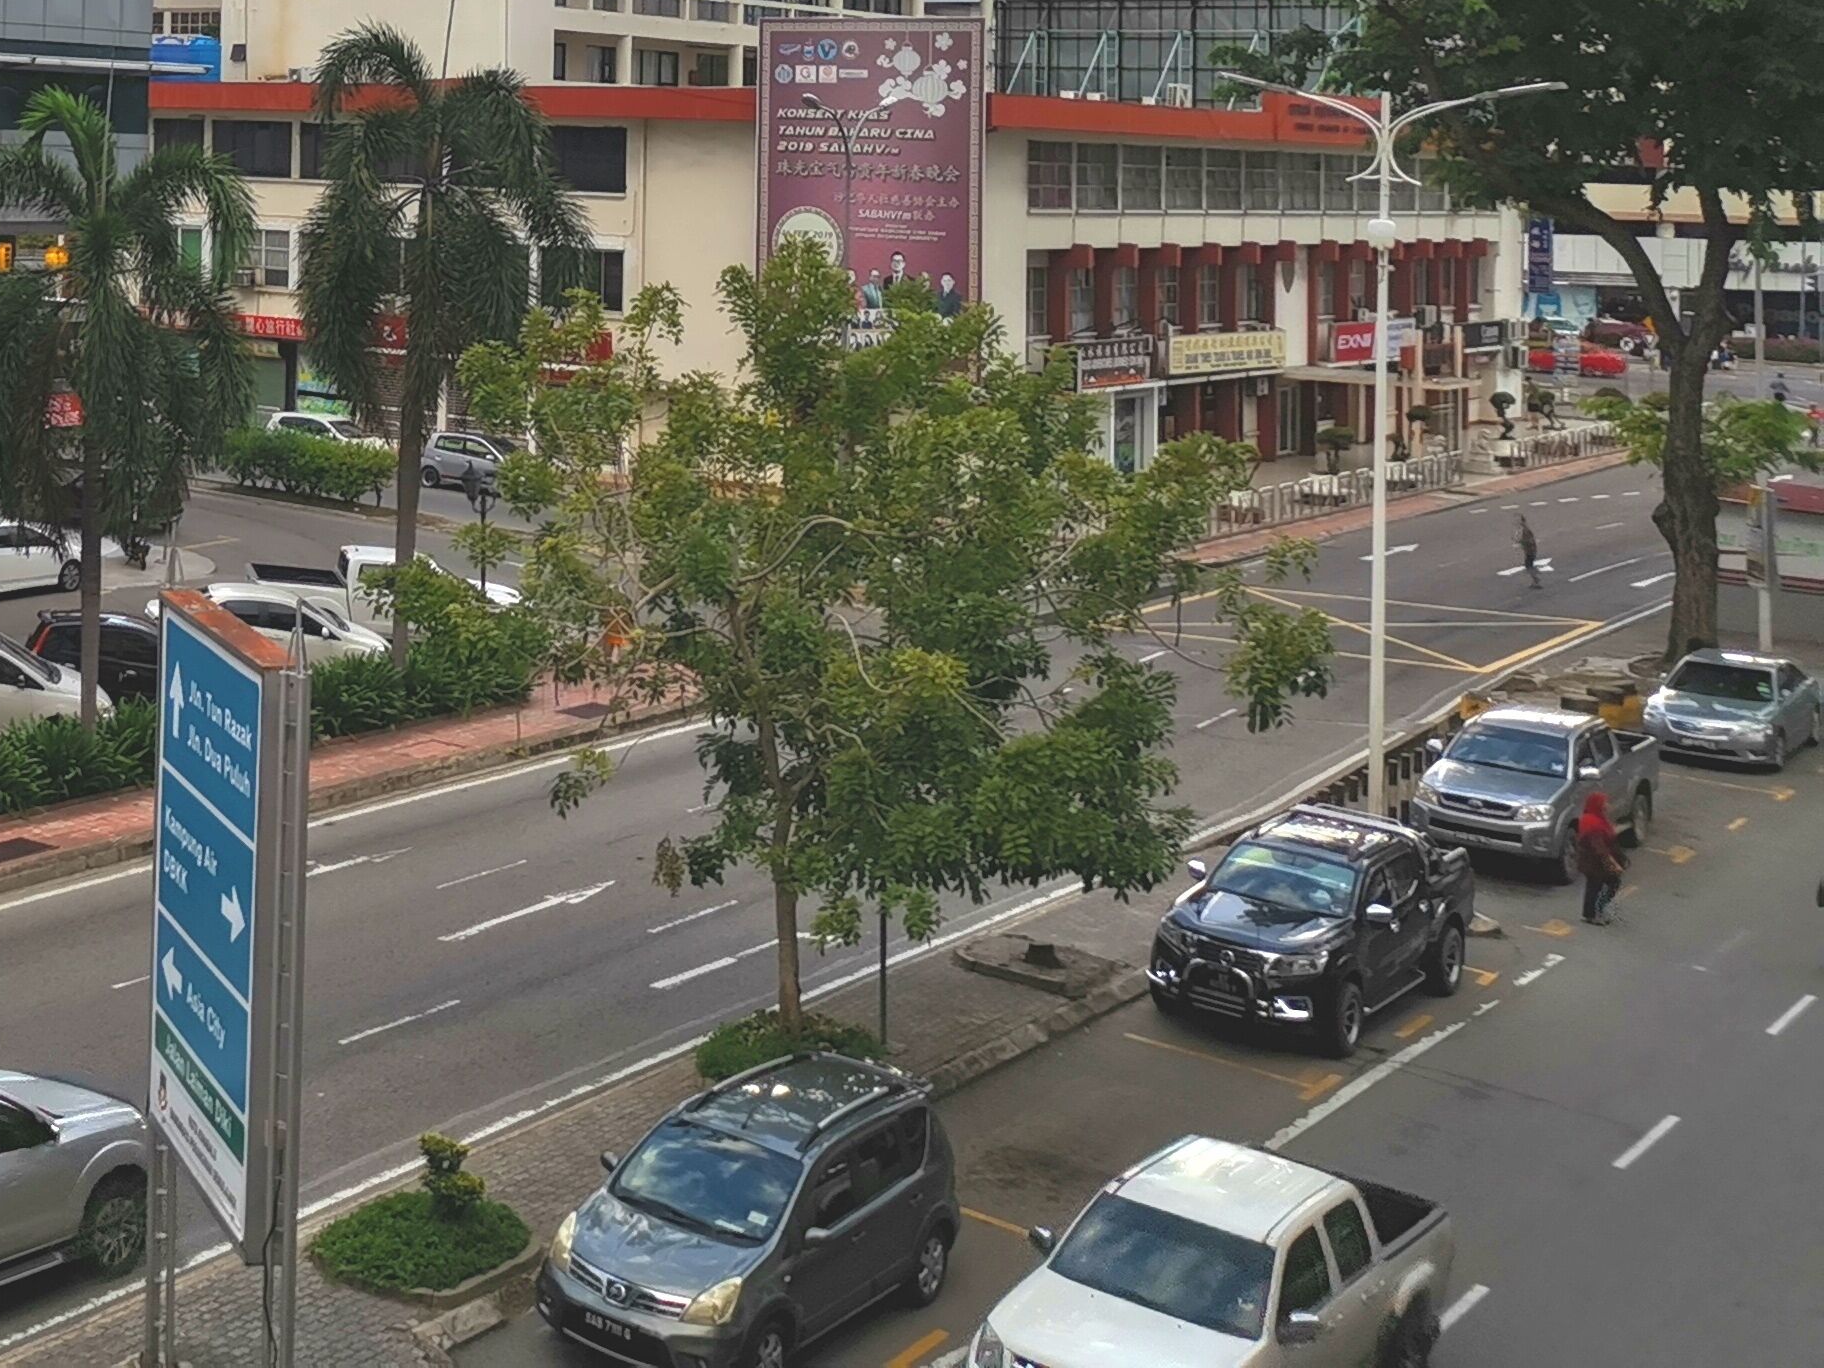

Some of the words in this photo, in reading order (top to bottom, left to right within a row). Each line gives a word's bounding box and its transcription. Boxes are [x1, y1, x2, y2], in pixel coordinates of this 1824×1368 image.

[777, 142, 815, 152] 2019
[778, 125, 825, 137] TAHUN
[895, 128, 936, 139] CINA
[189, 680, 205, 713] Jln.
[206, 691, 223, 727] Tun
[224, 707, 253, 752] Razak
[187, 724, 203, 757] Jln.
[204, 735, 223, 774] Dua
[224, 753, 251, 799] Puluh
[164, 804, 203, 868] Kampung
[203, 845, 218, 877] Air
[186, 982, 205, 1026] Asia
[206, 1009, 226, 1050] City
